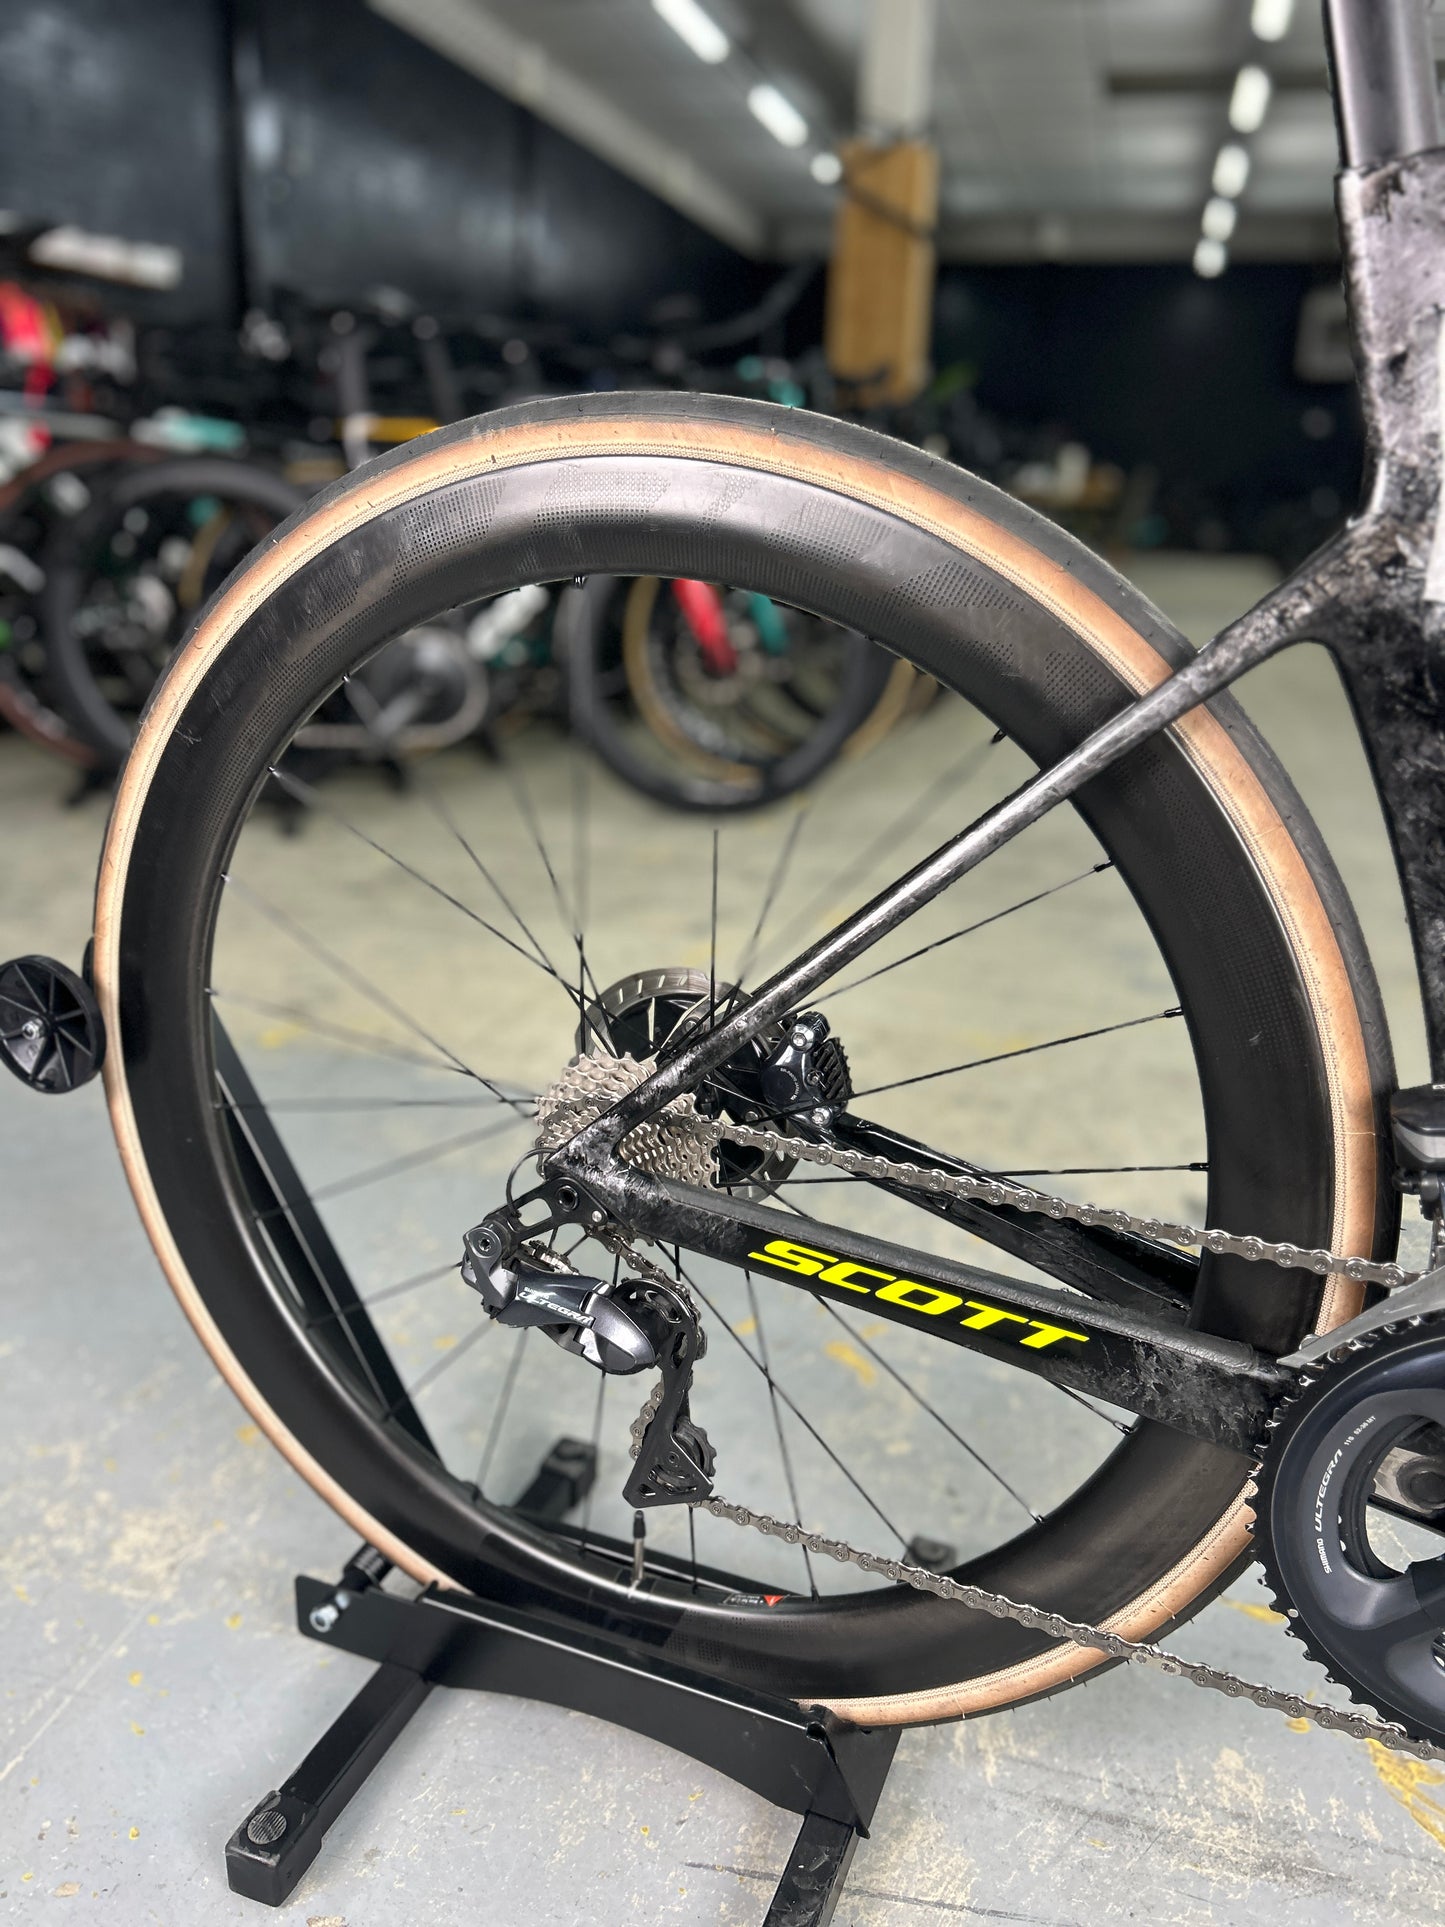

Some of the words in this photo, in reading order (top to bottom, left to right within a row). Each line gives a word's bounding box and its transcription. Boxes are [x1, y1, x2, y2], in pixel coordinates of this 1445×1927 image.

[748, 1240, 1089, 1349] SCOTT
[1315, 1449, 1343, 1533] ULTEGRA
[1316, 1538, 1332, 1574] SHIMANO
